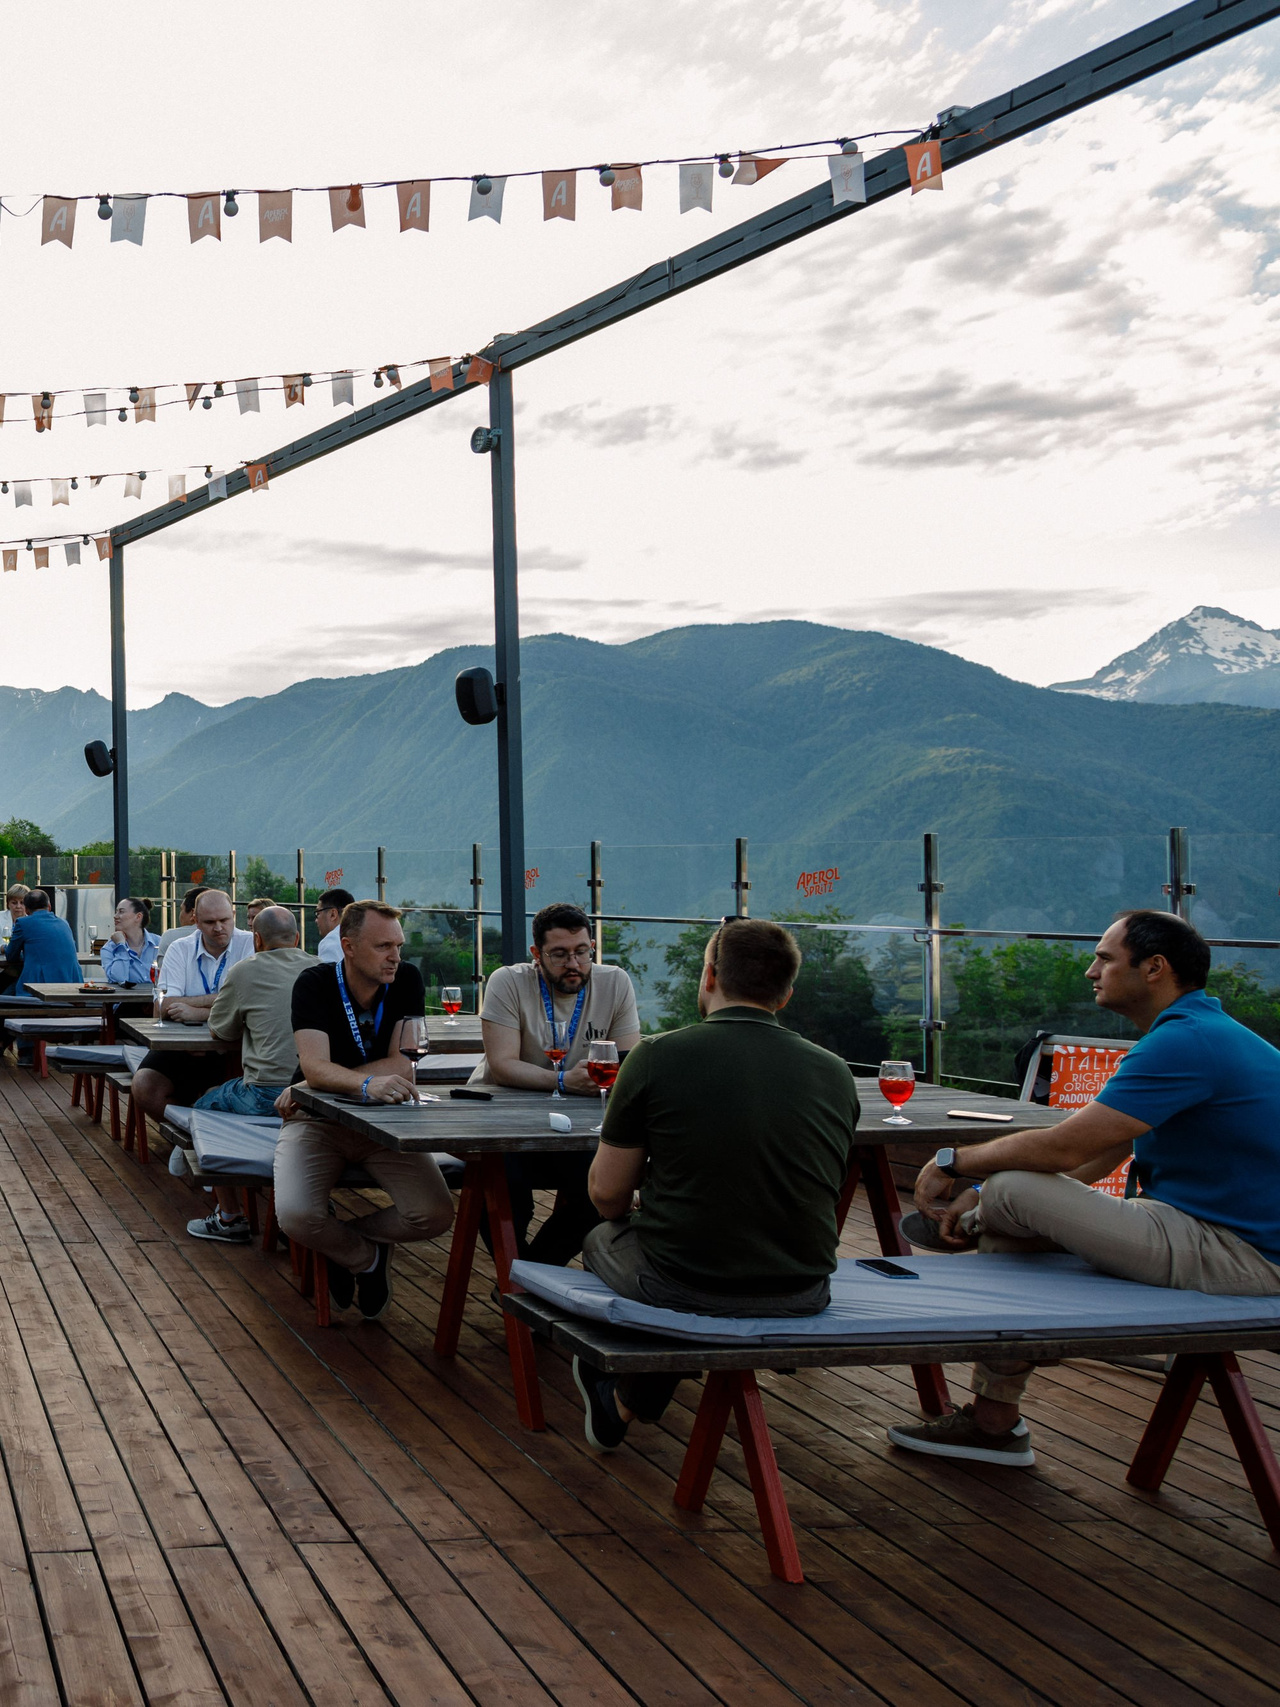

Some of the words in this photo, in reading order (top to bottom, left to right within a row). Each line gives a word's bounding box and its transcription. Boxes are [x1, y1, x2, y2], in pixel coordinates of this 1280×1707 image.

[916, 152, 931, 179] A
[406, 191, 421, 218] A
[552, 181, 567, 207] A
[50, 206, 68, 232] A
[198, 200, 215, 226] A
[255, 470, 264, 485] A
[796, 867, 840, 890] APEROL
[1064, 1082, 1106, 1092] ORIGIN
[1072, 1072, 1115, 1082] RICETT
[1059, 1093, 1094, 1104] PADOVA
